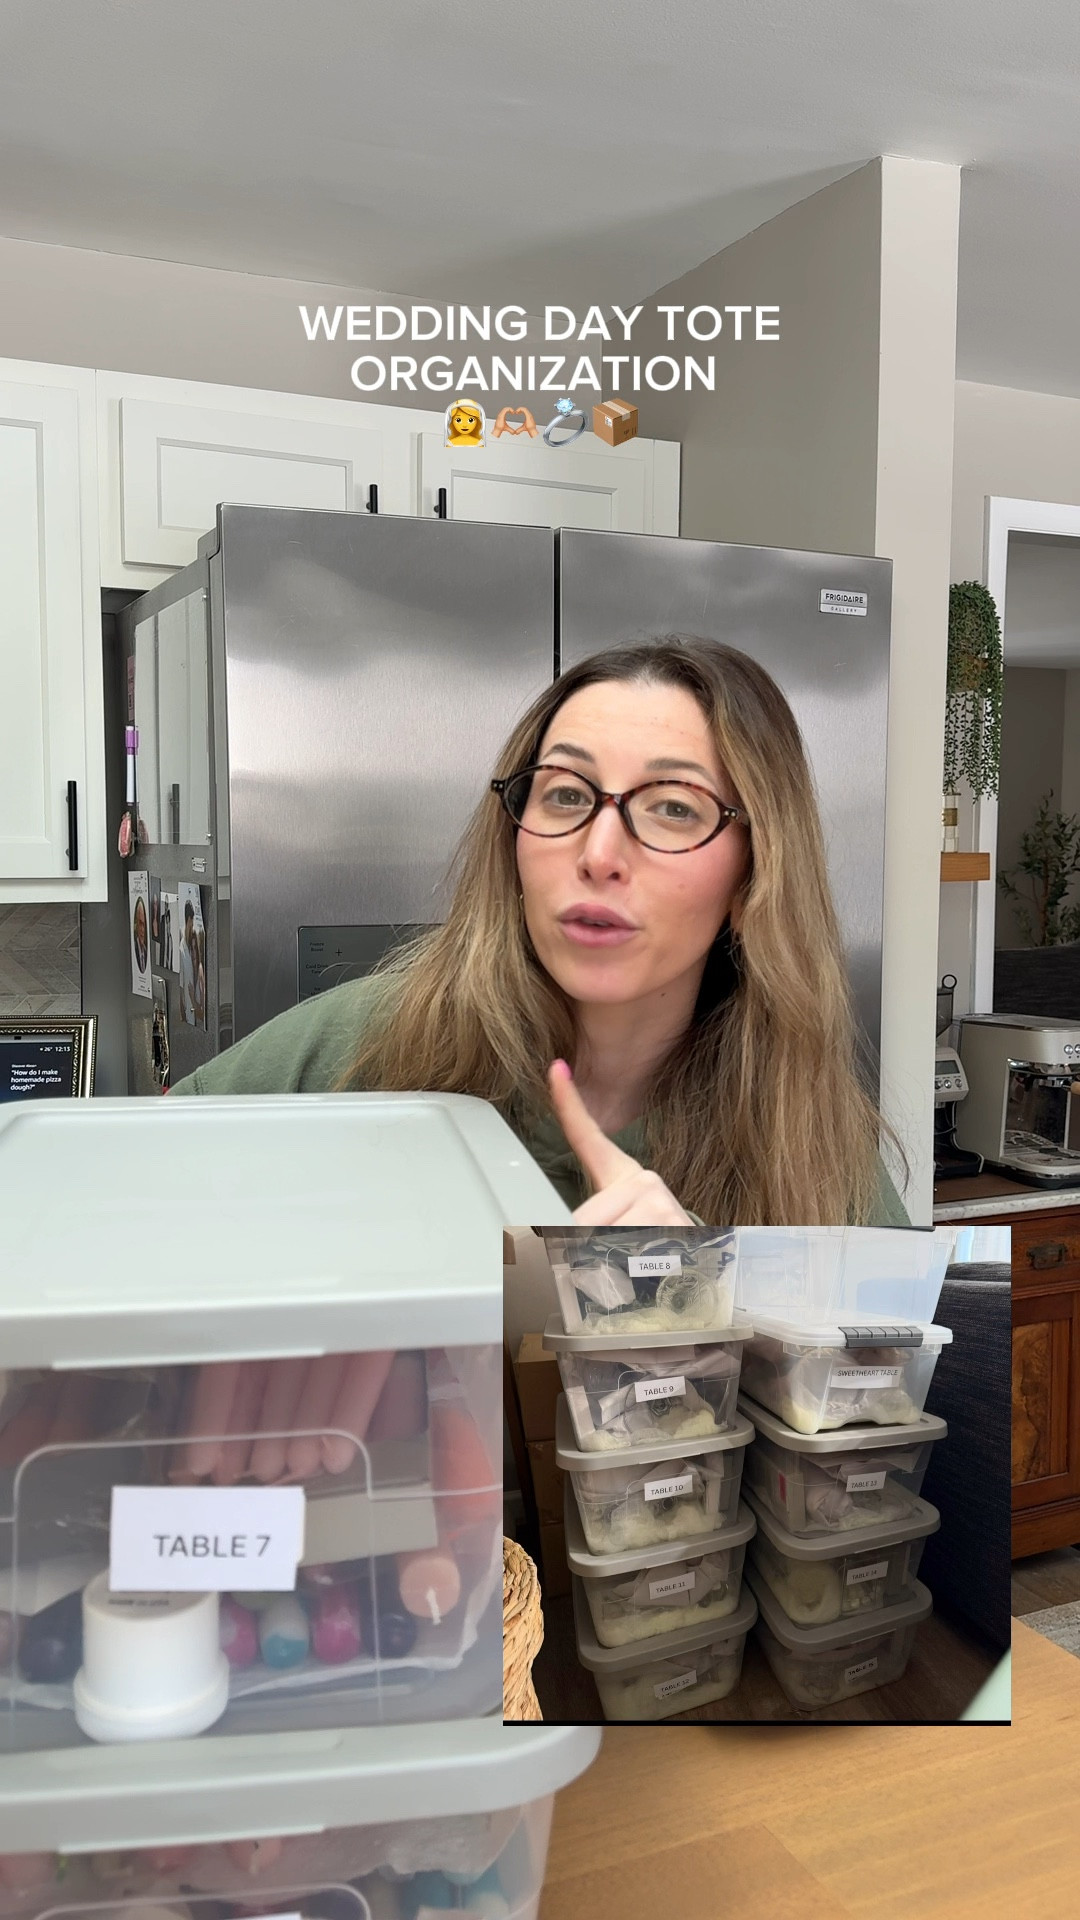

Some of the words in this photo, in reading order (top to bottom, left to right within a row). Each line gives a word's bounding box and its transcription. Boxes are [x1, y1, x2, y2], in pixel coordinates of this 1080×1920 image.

[825, 593, 864, 603] FRIGIDAIRE
[837, 1369, 880, 1377] SWEETHEART
[644, 1386, 668, 1396] TABLE
[651, 1487, 673, 1495] TABLE
[153, 1534, 248, 1558] TABLE
[255, 1534, 272, 1558] 7
[655, 1583, 677, 1593] TABLE
